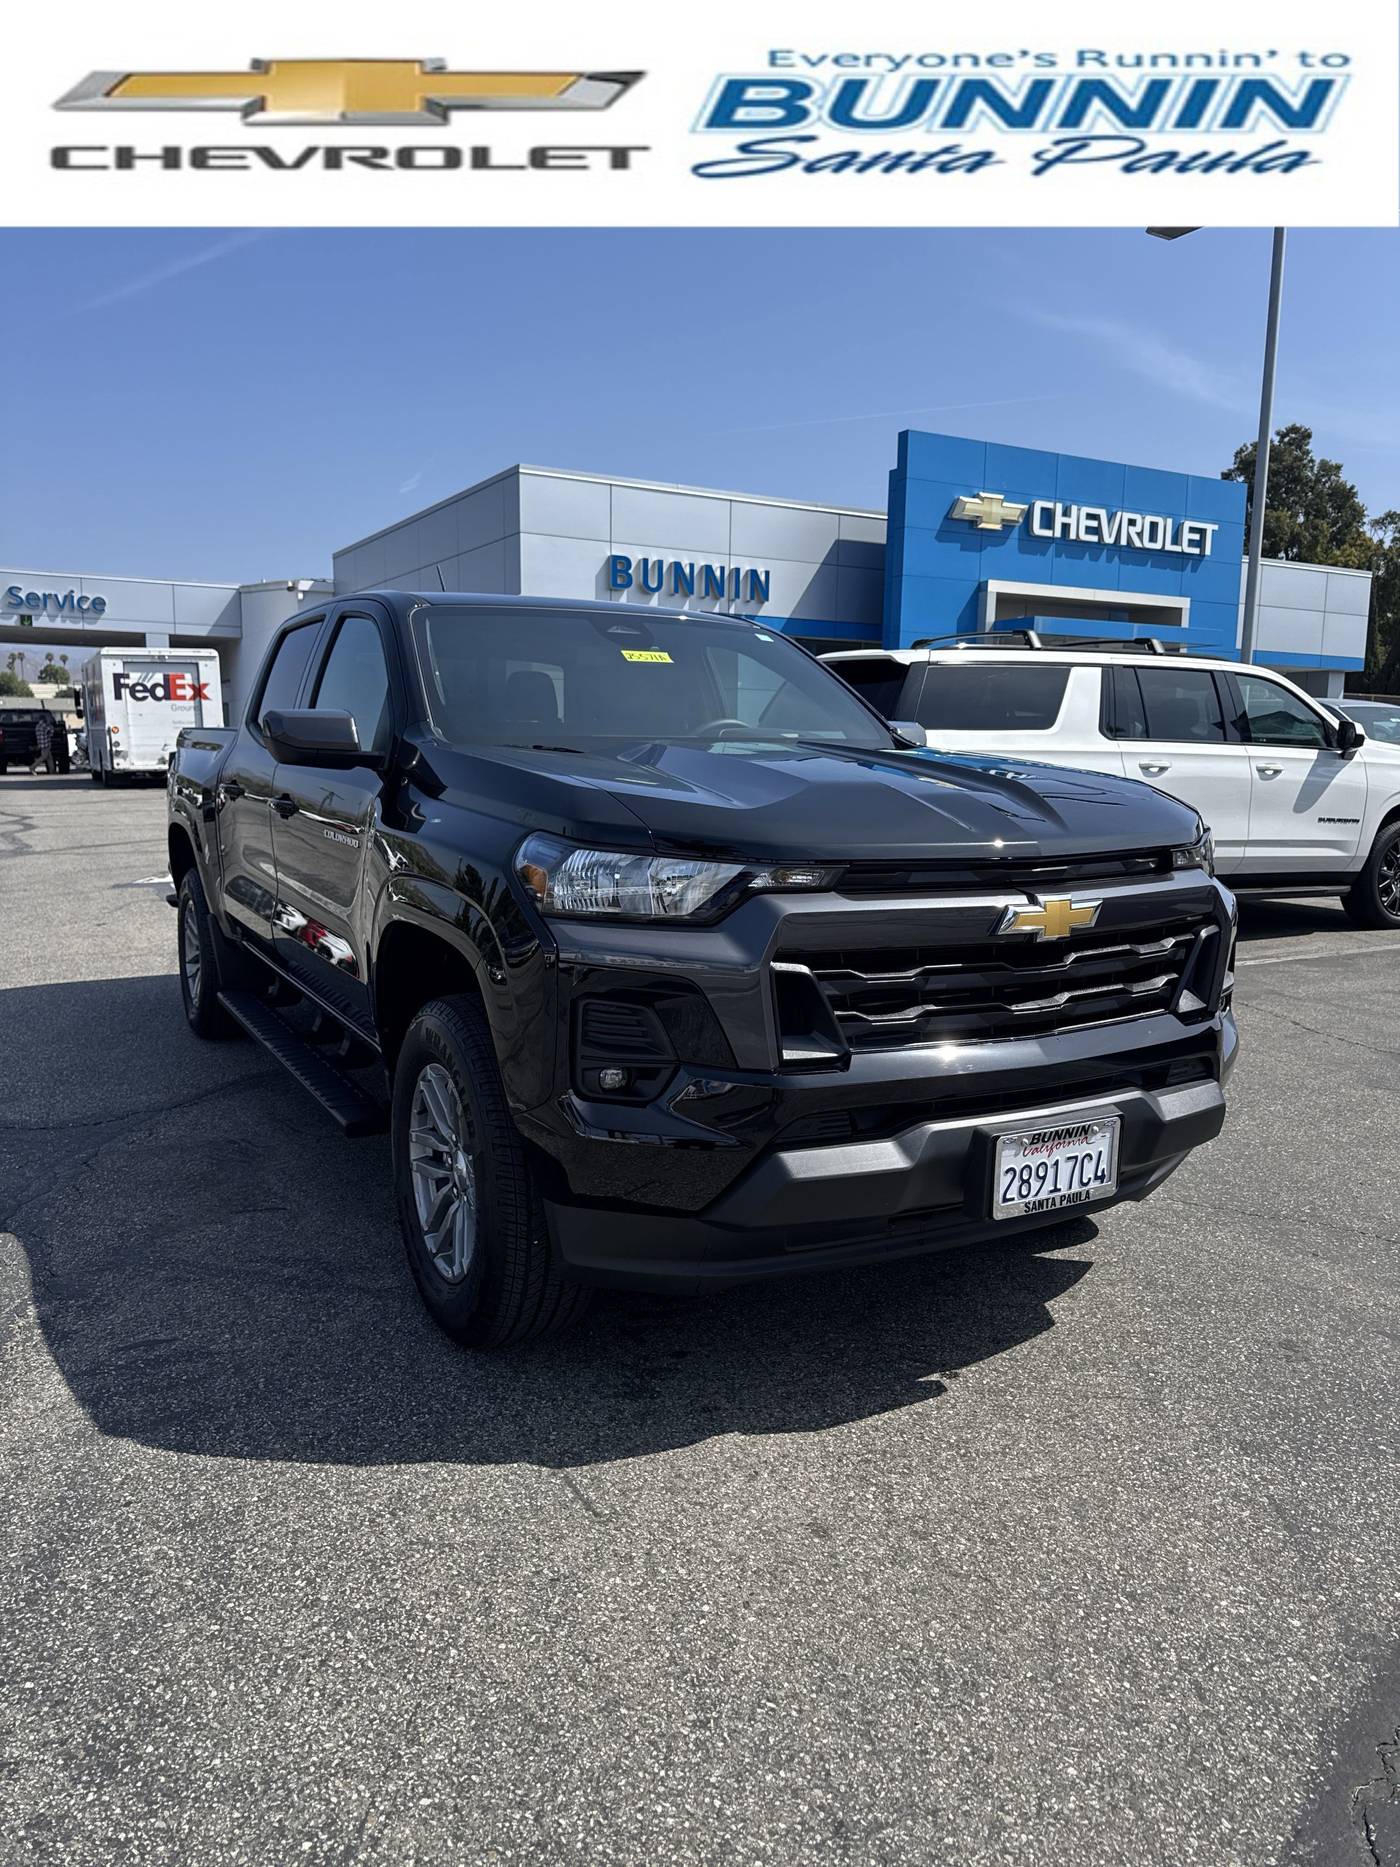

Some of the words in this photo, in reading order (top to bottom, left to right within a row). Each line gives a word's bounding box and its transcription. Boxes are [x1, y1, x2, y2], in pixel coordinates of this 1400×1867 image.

[1031, 499, 1218, 556] CHEVROLET
[608, 553, 772, 602] BUNNIN
[6, 585, 107, 615] Service
[112, 672, 212, 702] FedEx
[1022, 1136, 1095, 1158] California
[1029, 1124, 1092, 1146] BUNNIN
[1002, 1149, 1106, 1203] 28917C4
[1024, 1196, 1057, 1214] SANTA
[1060, 1189, 1091, 1206] PAULA
